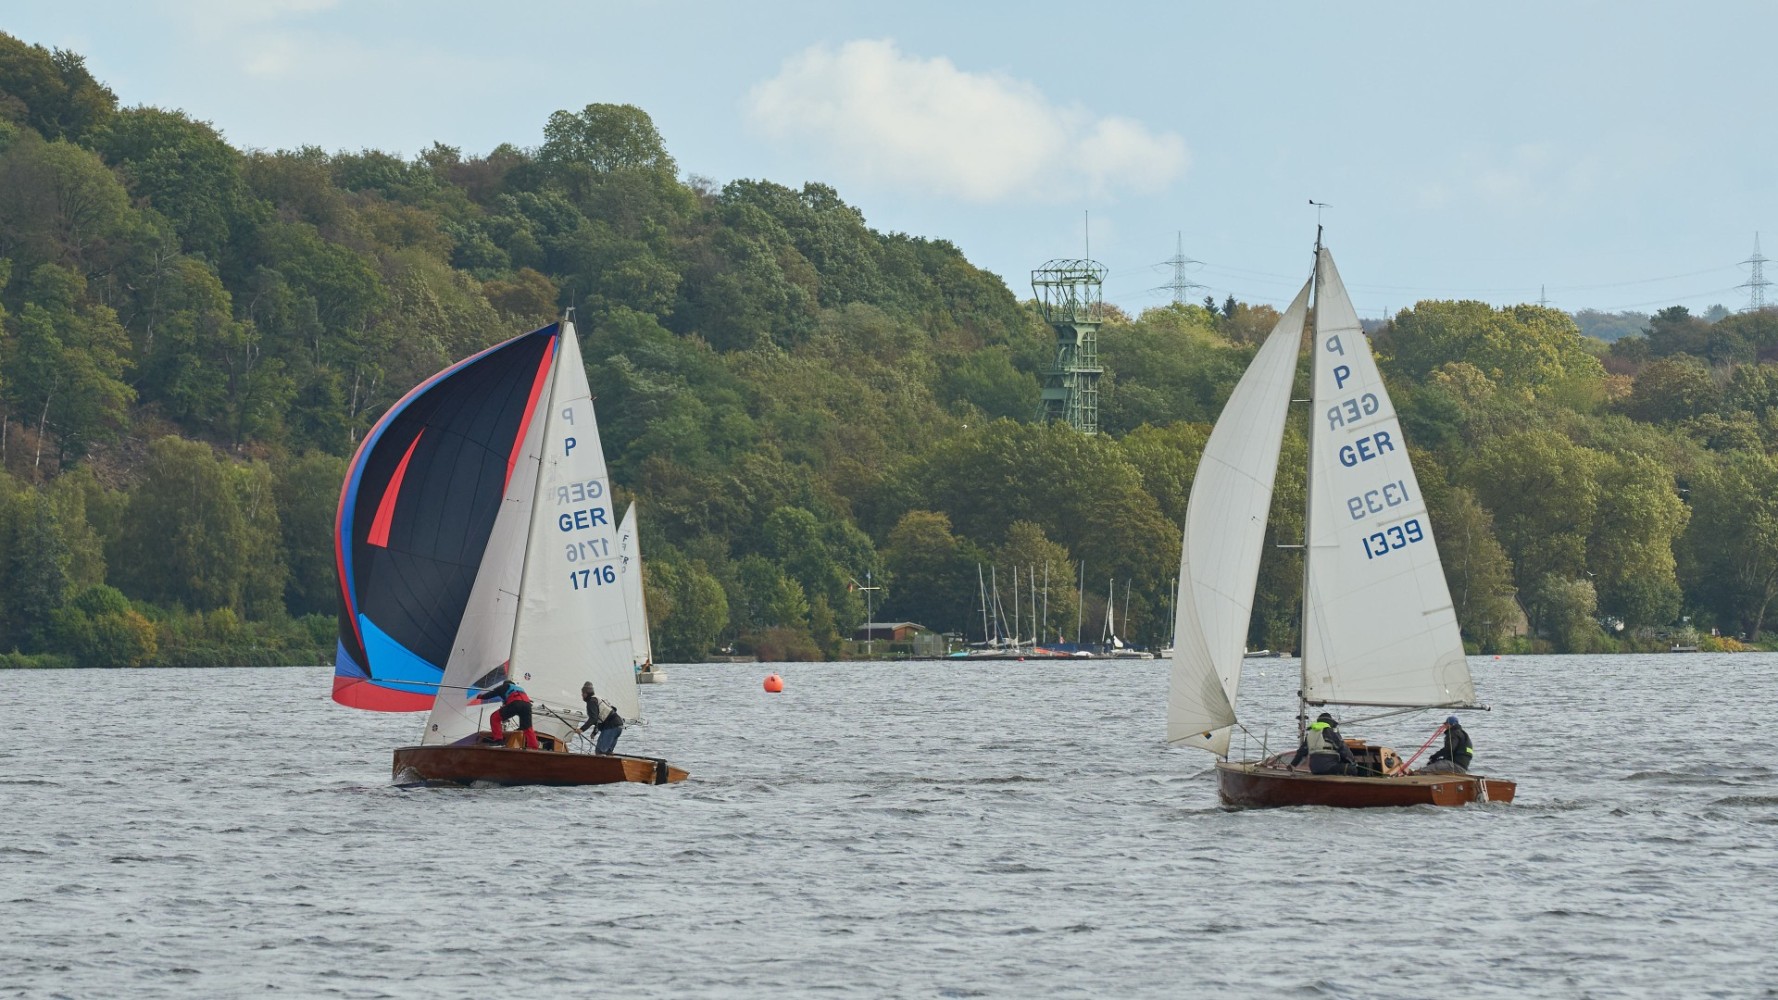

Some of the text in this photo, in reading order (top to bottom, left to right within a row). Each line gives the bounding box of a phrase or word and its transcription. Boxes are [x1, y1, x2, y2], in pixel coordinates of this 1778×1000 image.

[1333, 365, 1351, 390] P
[564, 437, 577, 457] P
[1339, 431, 1395, 468] GER
[558, 507, 608, 532] GER
[1362, 519, 1424, 560] 1339
[569, 565, 616, 590] 1716
